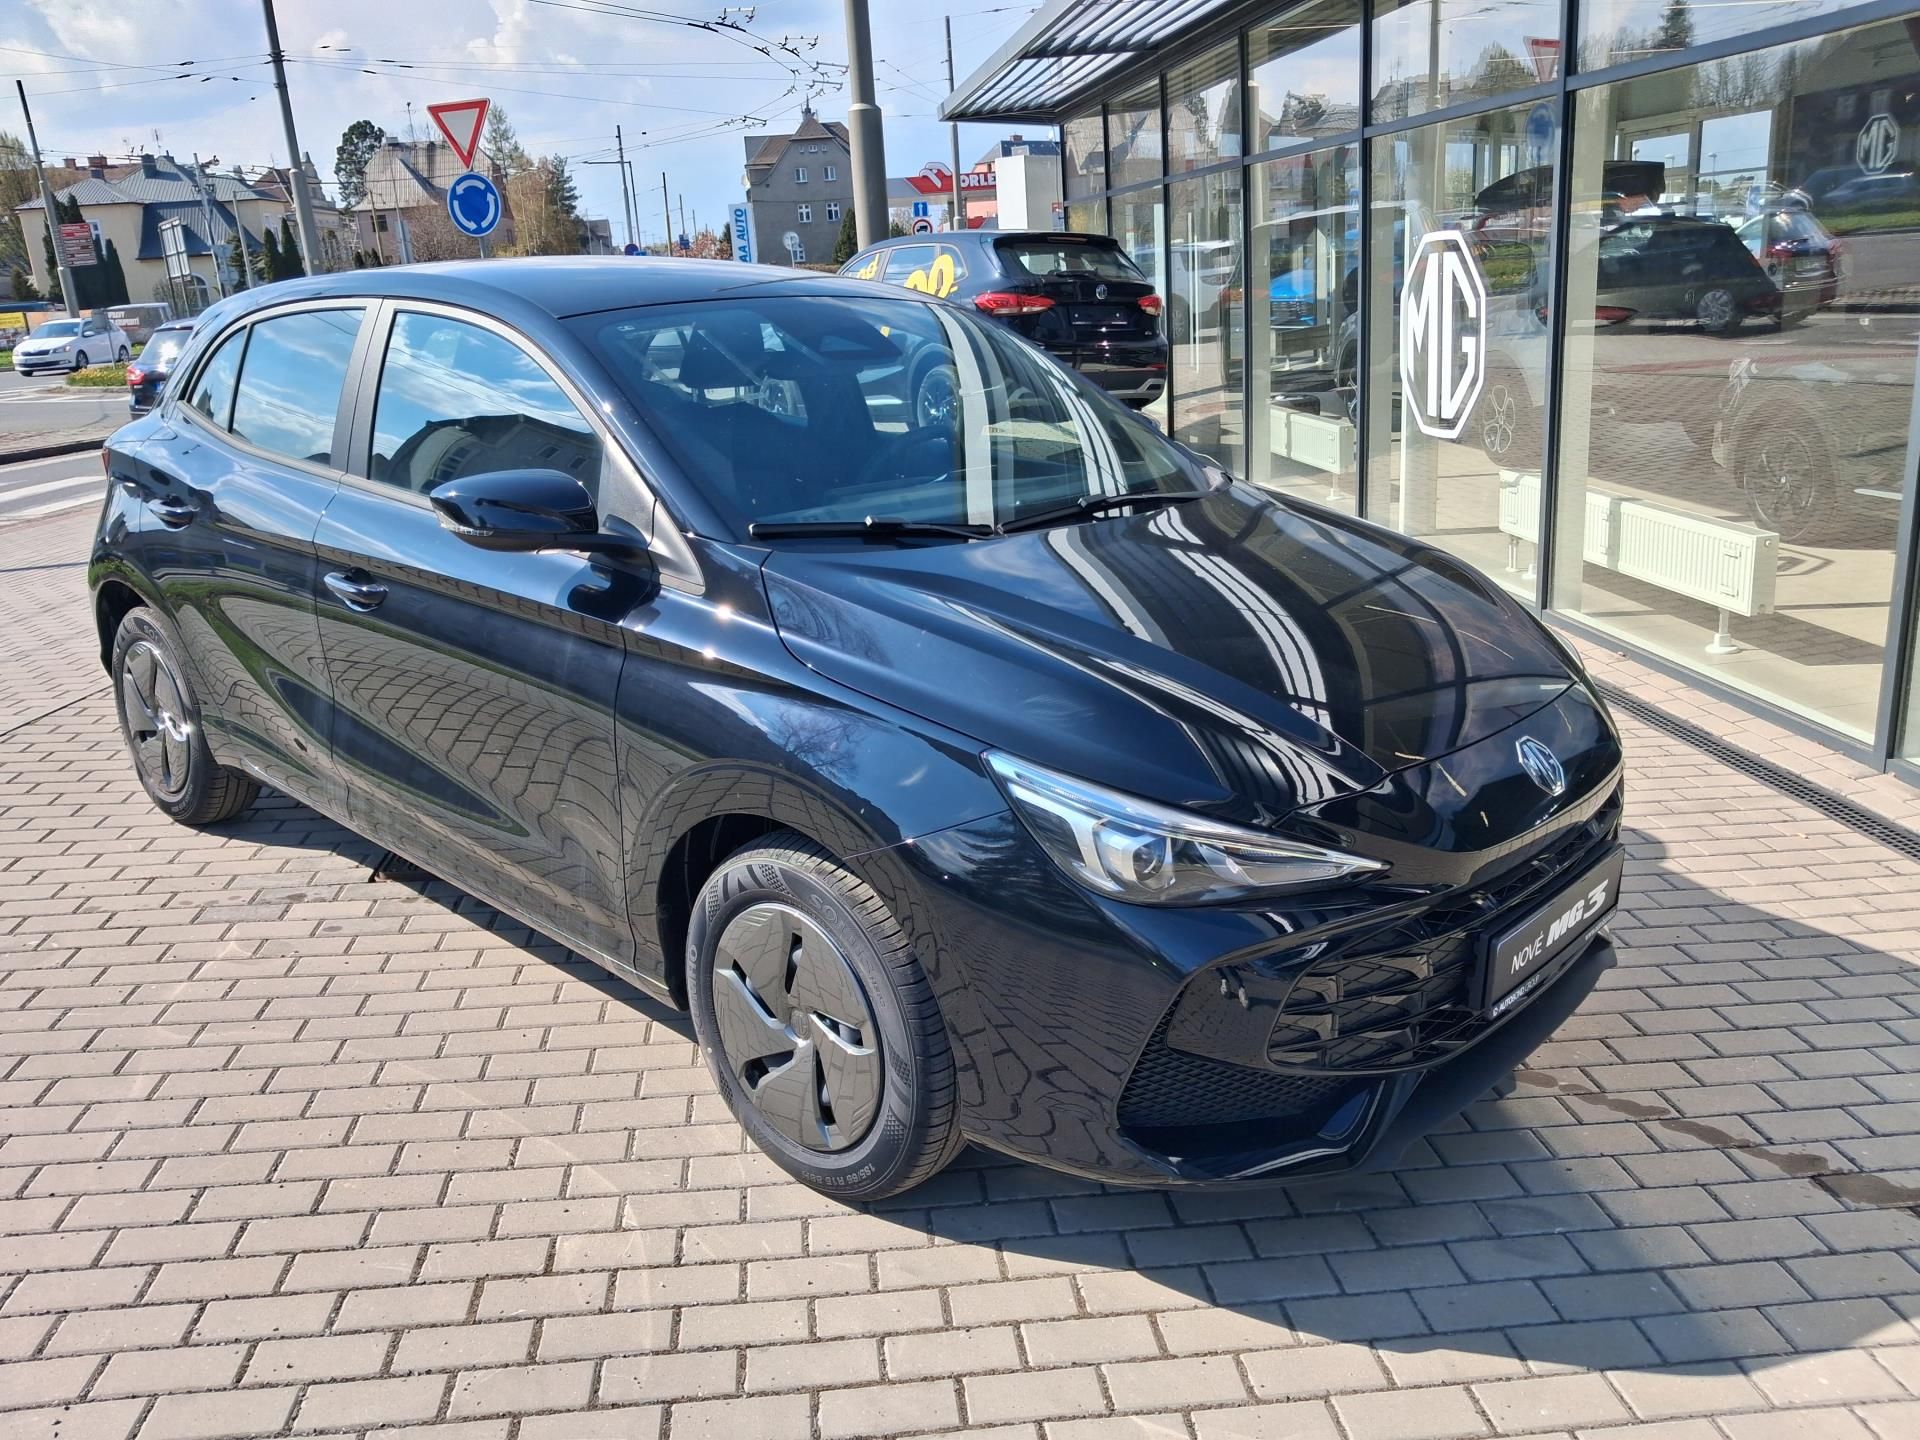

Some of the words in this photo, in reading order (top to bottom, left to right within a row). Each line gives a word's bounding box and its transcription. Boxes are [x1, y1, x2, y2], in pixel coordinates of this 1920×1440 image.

[1859, 119, 1897, 170] MG
[734, 208, 746, 241] AUTO
[1408, 252, 1477, 419] MG
[1519, 738, 1564, 794] MG
[1511, 931, 1544, 974] NOVÉ
